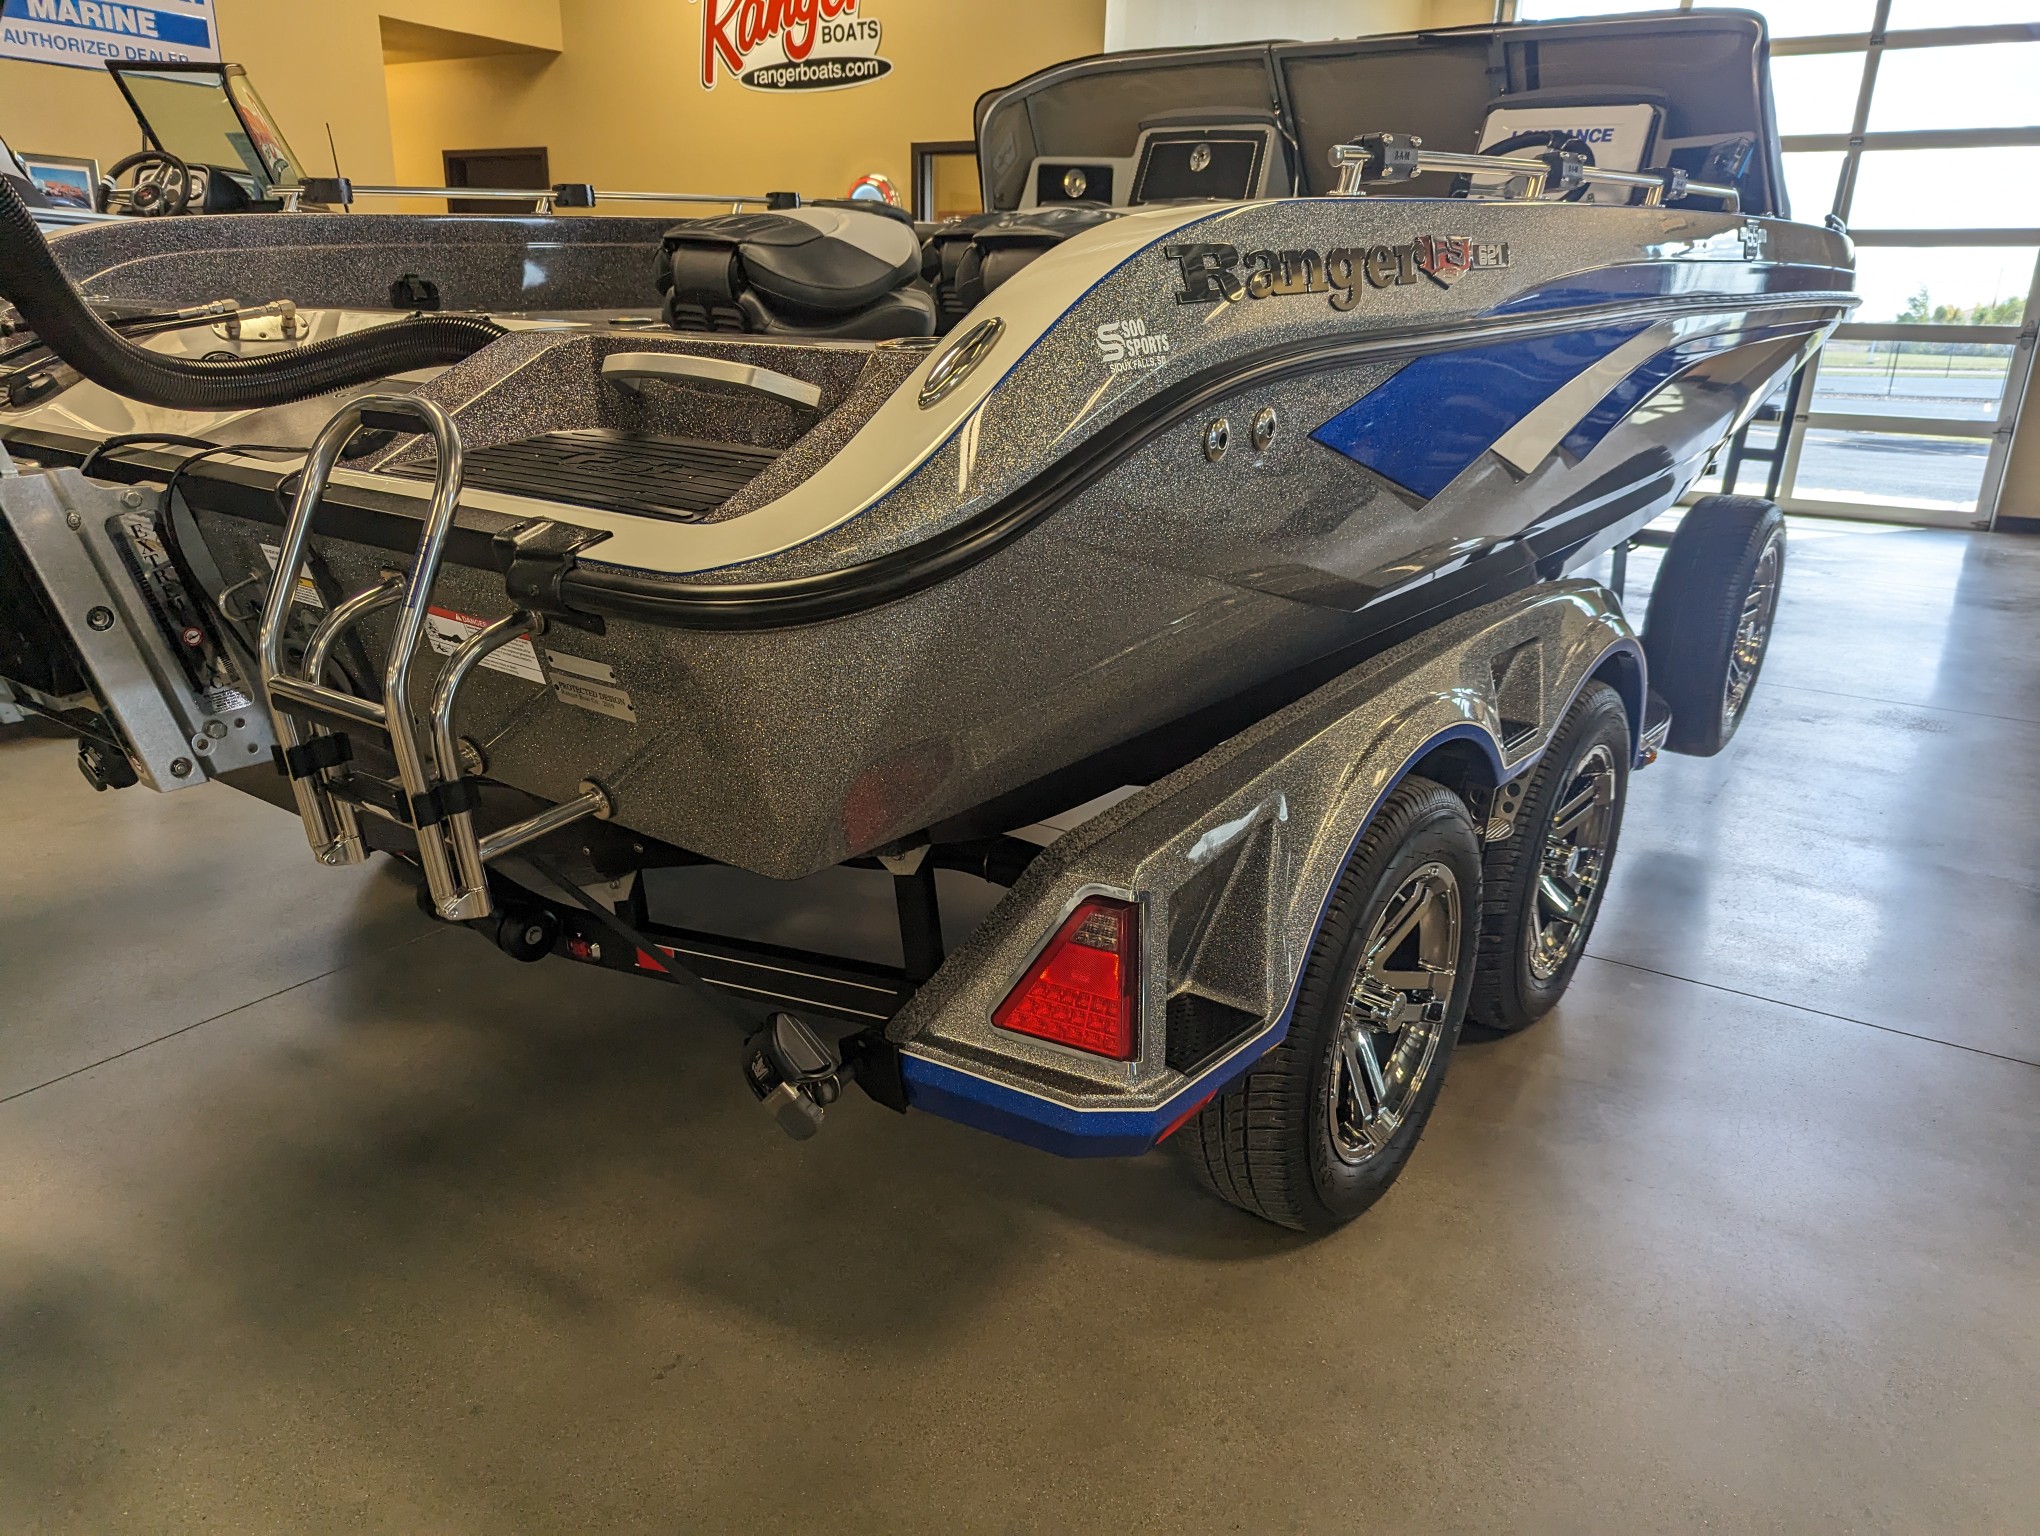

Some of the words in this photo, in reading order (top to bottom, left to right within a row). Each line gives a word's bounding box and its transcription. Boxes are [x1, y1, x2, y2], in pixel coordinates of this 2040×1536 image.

[27, 0, 160, 38] MARINE
[4, 28, 120, 58] AUTHORIZED
[822, 20, 879, 44] BOATS
[754, 60, 879, 87] rangerboats.com
[1164, 242, 1428, 312] Ranger
[1478, 245, 1503, 266] 621
[1121, 318, 1146, 339] SOO
[1126, 333, 1170, 357] SPORTS
[1109, 361, 1134, 374] SIOUX
[558, 681, 598, 699] PROTECTED
[598, 692, 626, 706] DESIGN
